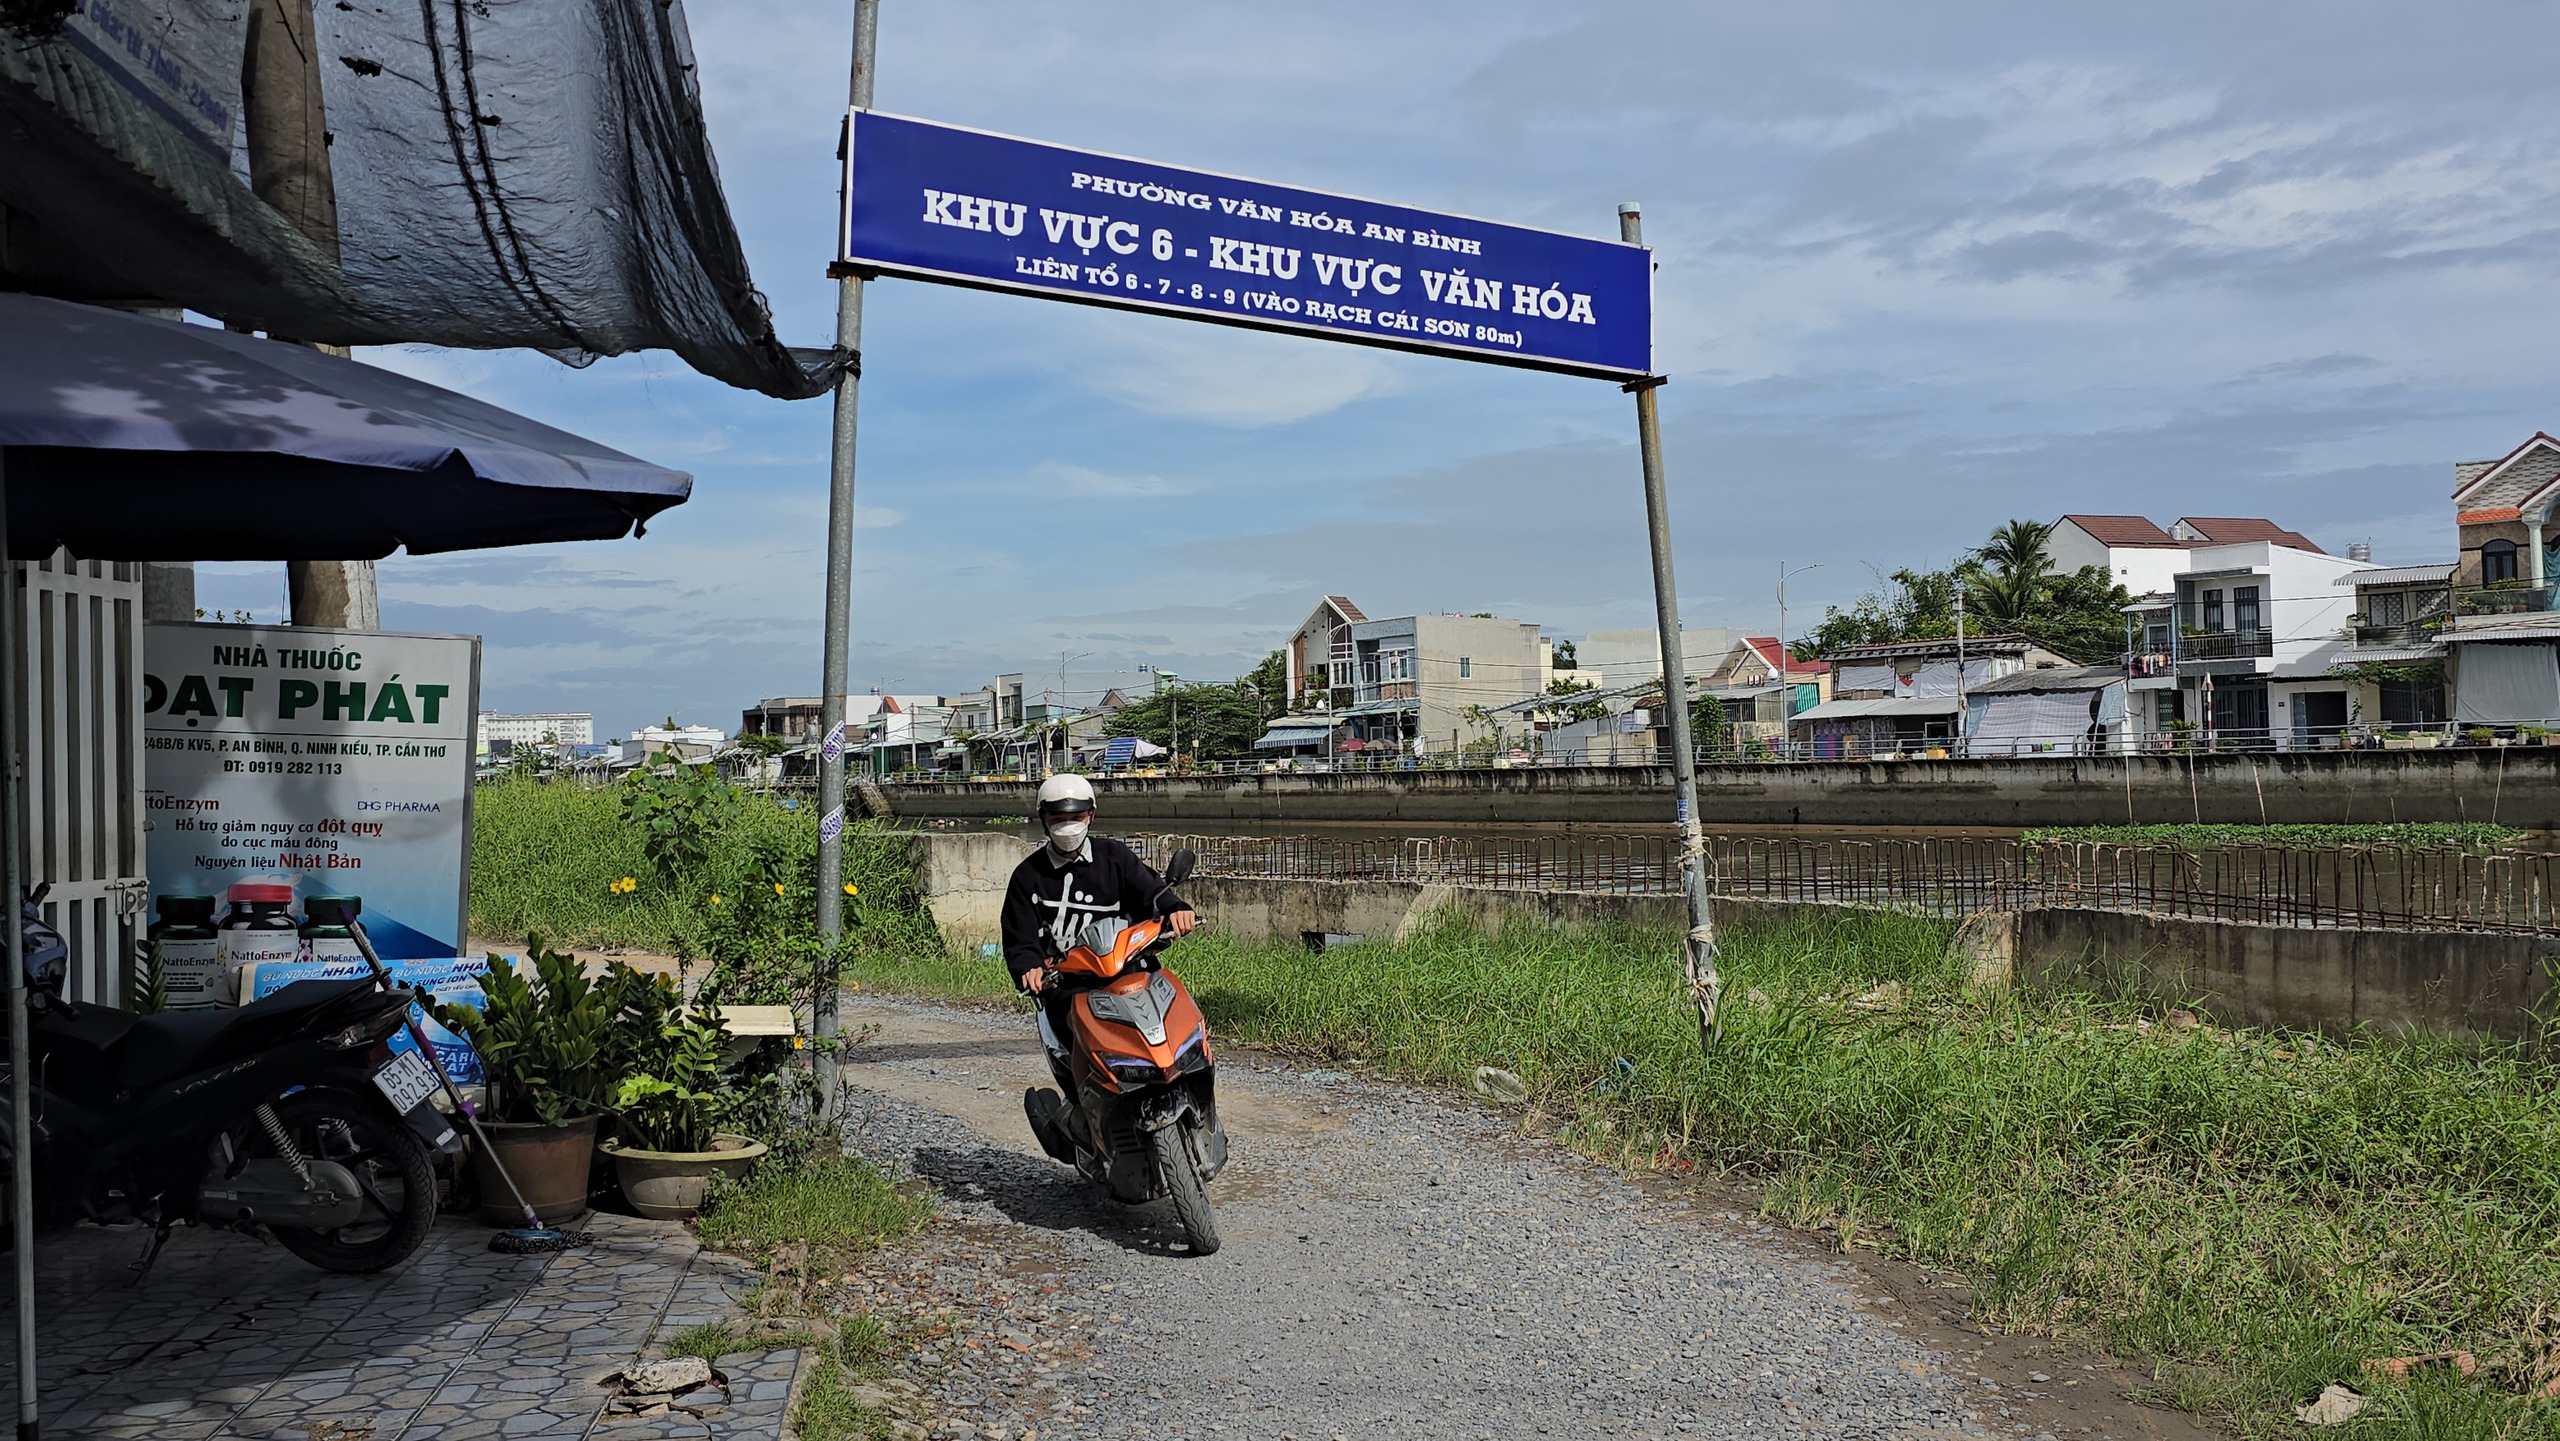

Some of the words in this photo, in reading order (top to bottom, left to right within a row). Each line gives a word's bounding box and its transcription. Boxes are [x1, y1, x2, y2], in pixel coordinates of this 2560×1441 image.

[1071, 172, 1212, 211] PHƯỜNG
[1218, 197, 1283, 223] VĂN
[1290, 211, 1356, 235] HÓA
[1361, 222, 1406, 244] AN
[1412, 228, 1481, 256] BÌNH
[922, 188, 1027, 237] KHU
[1039, 208, 1140, 256] VỰC
[1151, 228, 1174, 261] 6
[1209, 236, 1301, 280] KHU
[1311, 252, 1402, 297] VỰC
[1420, 267, 1503, 311] VĂN
[1511, 281, 1597, 325] HÓA
[1015, 256, 1079, 282] LIÊN
[1084, 262, 1120, 287] TỔ
[1125, 273, 1138, 290] 6
[1158, 278, 1171, 295] 7
[1190, 283, 1204, 300] 8
[1223, 288, 1236, 305] 9
[1242, 291, 1300, 314] (VÀO
[1305, 300, 1372, 325] RẠCH
[1377, 309, 1419, 332] CÁI
[1424, 318, 1471, 338] SƠN
[1475, 325, 1523, 348] 80m)
[213, 643, 269, 668] NHÀ
[277, 645, 362, 671] THUỐC
[278, 673, 449, 725] PHÁT
[188, 738, 215, 752] KV5,
[218, 739, 229, 752] P.
[232, 740, 250, 753] AN
[254, 738, 287, 754] BÌNH,
[291, 741, 303, 755] Q.
[306, 742, 337, 755] NINH
[376, 744, 391, 756] TP.
[423, 745, 447, 758] THƠ
[224, 760, 245, 772] ĐT:
[249, 761, 283, 773] 0919
[287, 762, 313, 775] 282
[317, 763, 342, 775] 113
[385, 801, 441, 813] PHARMA
[175, 817, 195, 831] Hỗ
[199, 819, 218, 834] trợ
[222, 819, 256, 834] giảm
[261, 823, 294, 835] nguy
[298, 823, 314, 833] cơ
[317, 818, 346, 836] đột
[351, 822, 383, 837] quỵ
[221, 835, 238, 847] do
[242, 838, 266, 850] cục
[271, 837, 300, 848] máu
[305, 837, 338, 851] đông
[194, 855, 246, 870] Nguyên
[251, 856, 276, 870] liệu
[279, 853, 322, 872] Nhật
[327, 853, 362, 869] Bản
[162, 957, 216, 968] NattoEnzym
[231, 951, 292, 962] NattoEnzym
[446, 975, 468, 984] ION
[393, 1070, 437, 1111] 092.93
